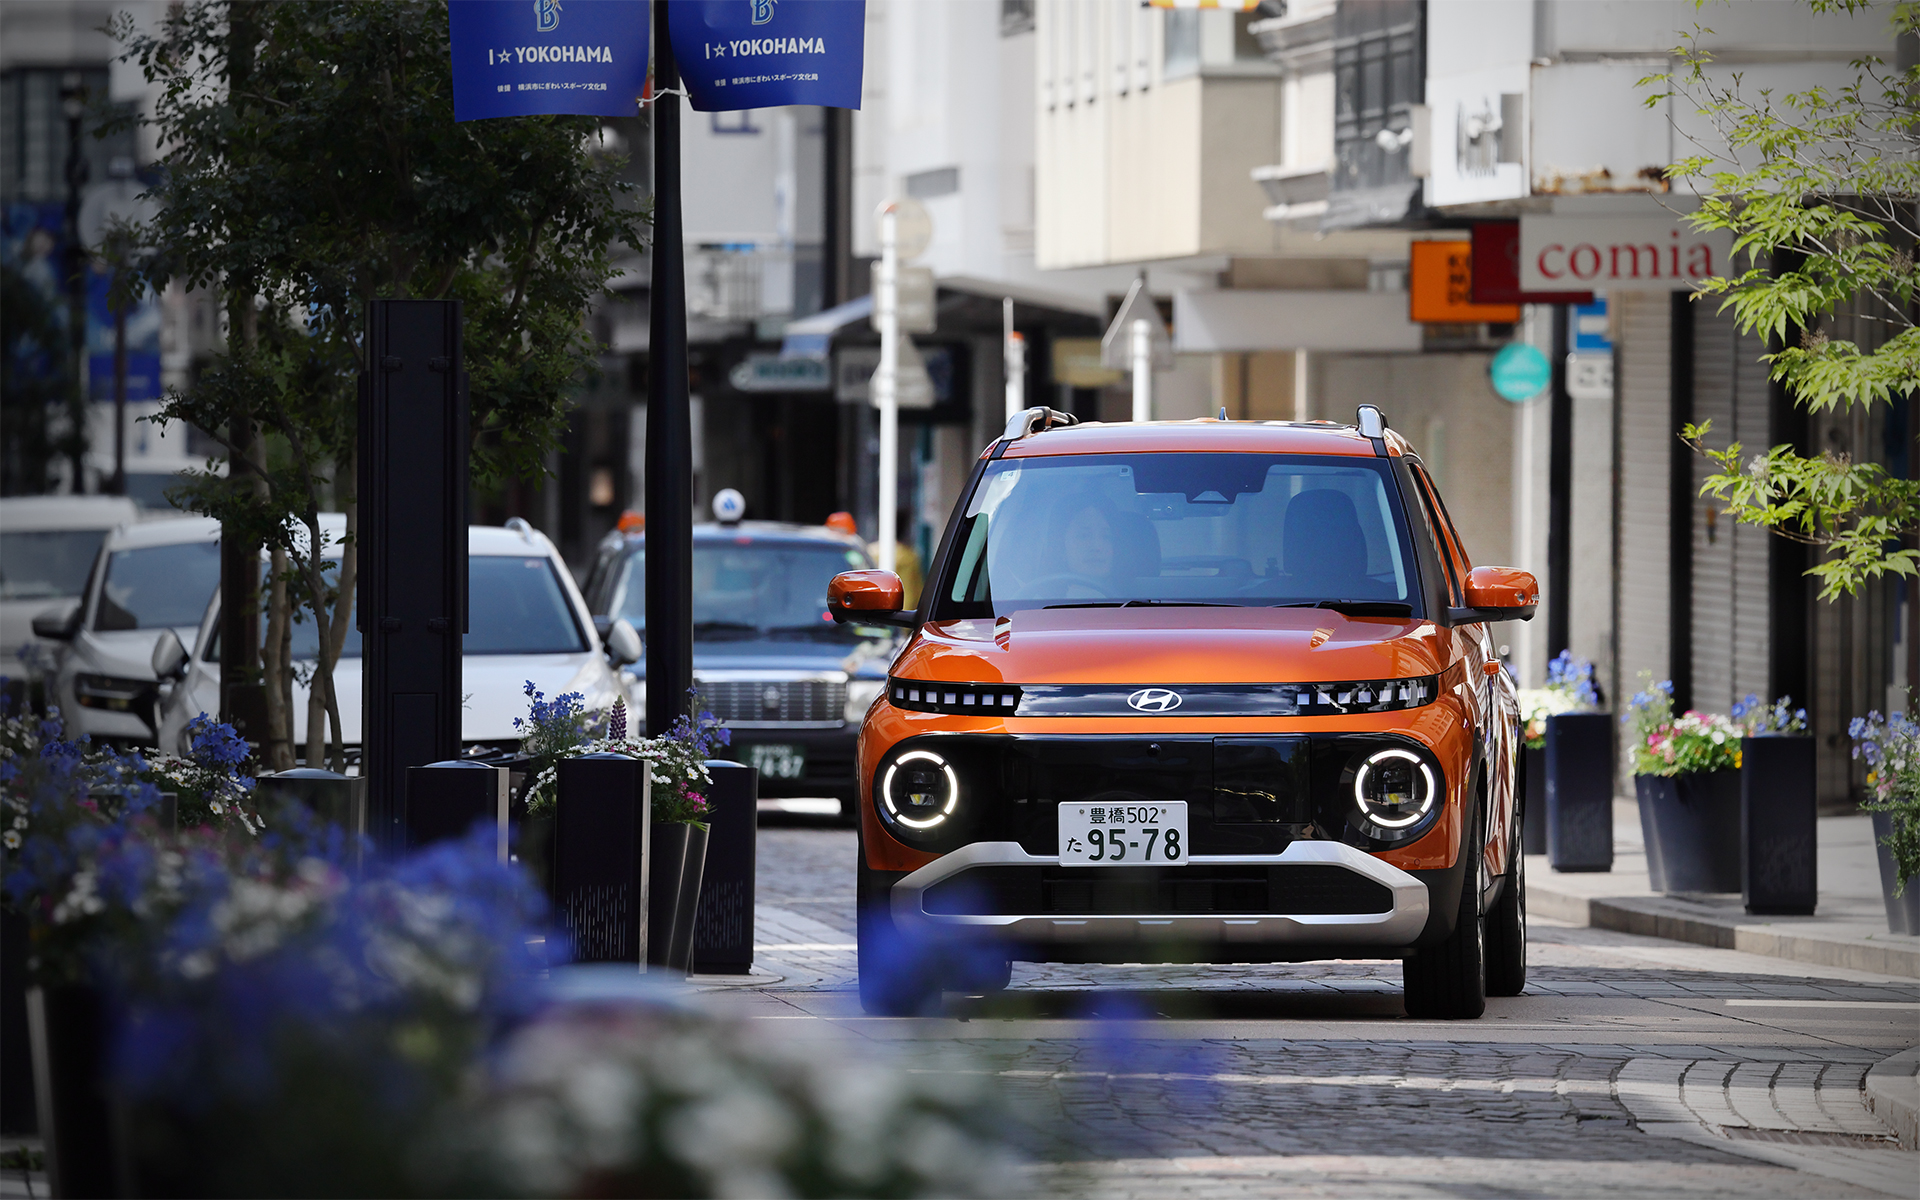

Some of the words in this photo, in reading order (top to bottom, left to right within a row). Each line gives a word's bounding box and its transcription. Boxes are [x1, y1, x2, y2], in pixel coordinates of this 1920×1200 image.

[515, 45, 613, 64] YOKOHAMA
[729, 37, 826, 57] YOKOHAMA
[497, 84, 511, 93] 後援
[518, 82, 607, 91] 横浜市にぎわいスポーツ文化局
[732, 73, 819, 86] 横浜市にぎわいスポーツ文化局
[1537, 229, 1716, 280] comia
[1067, 837, 1083, 853] た
[1087, 828, 1181, 861] 95-78
